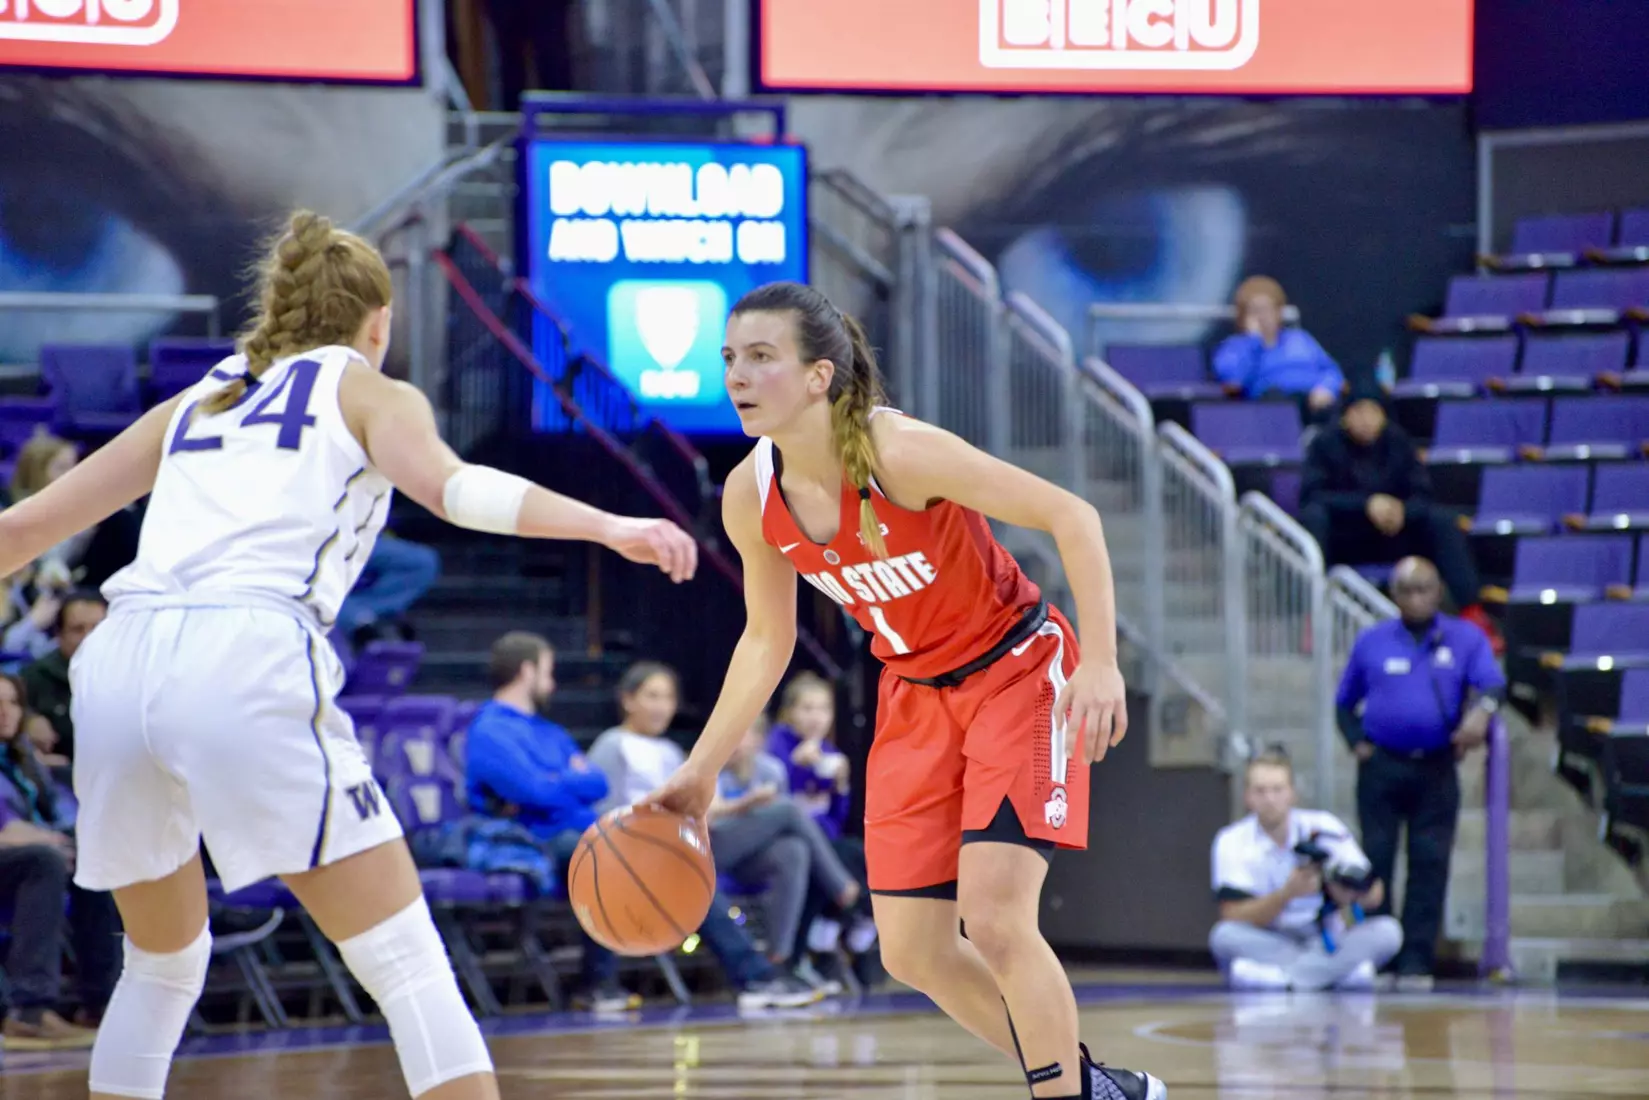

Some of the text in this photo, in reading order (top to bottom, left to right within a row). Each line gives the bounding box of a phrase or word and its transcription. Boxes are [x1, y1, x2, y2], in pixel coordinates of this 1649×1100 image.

[168, 359, 322, 455] 24
[841, 551, 938, 603] STATE
[868, 606, 912, 655] 1
[345, 780, 381, 821] W
